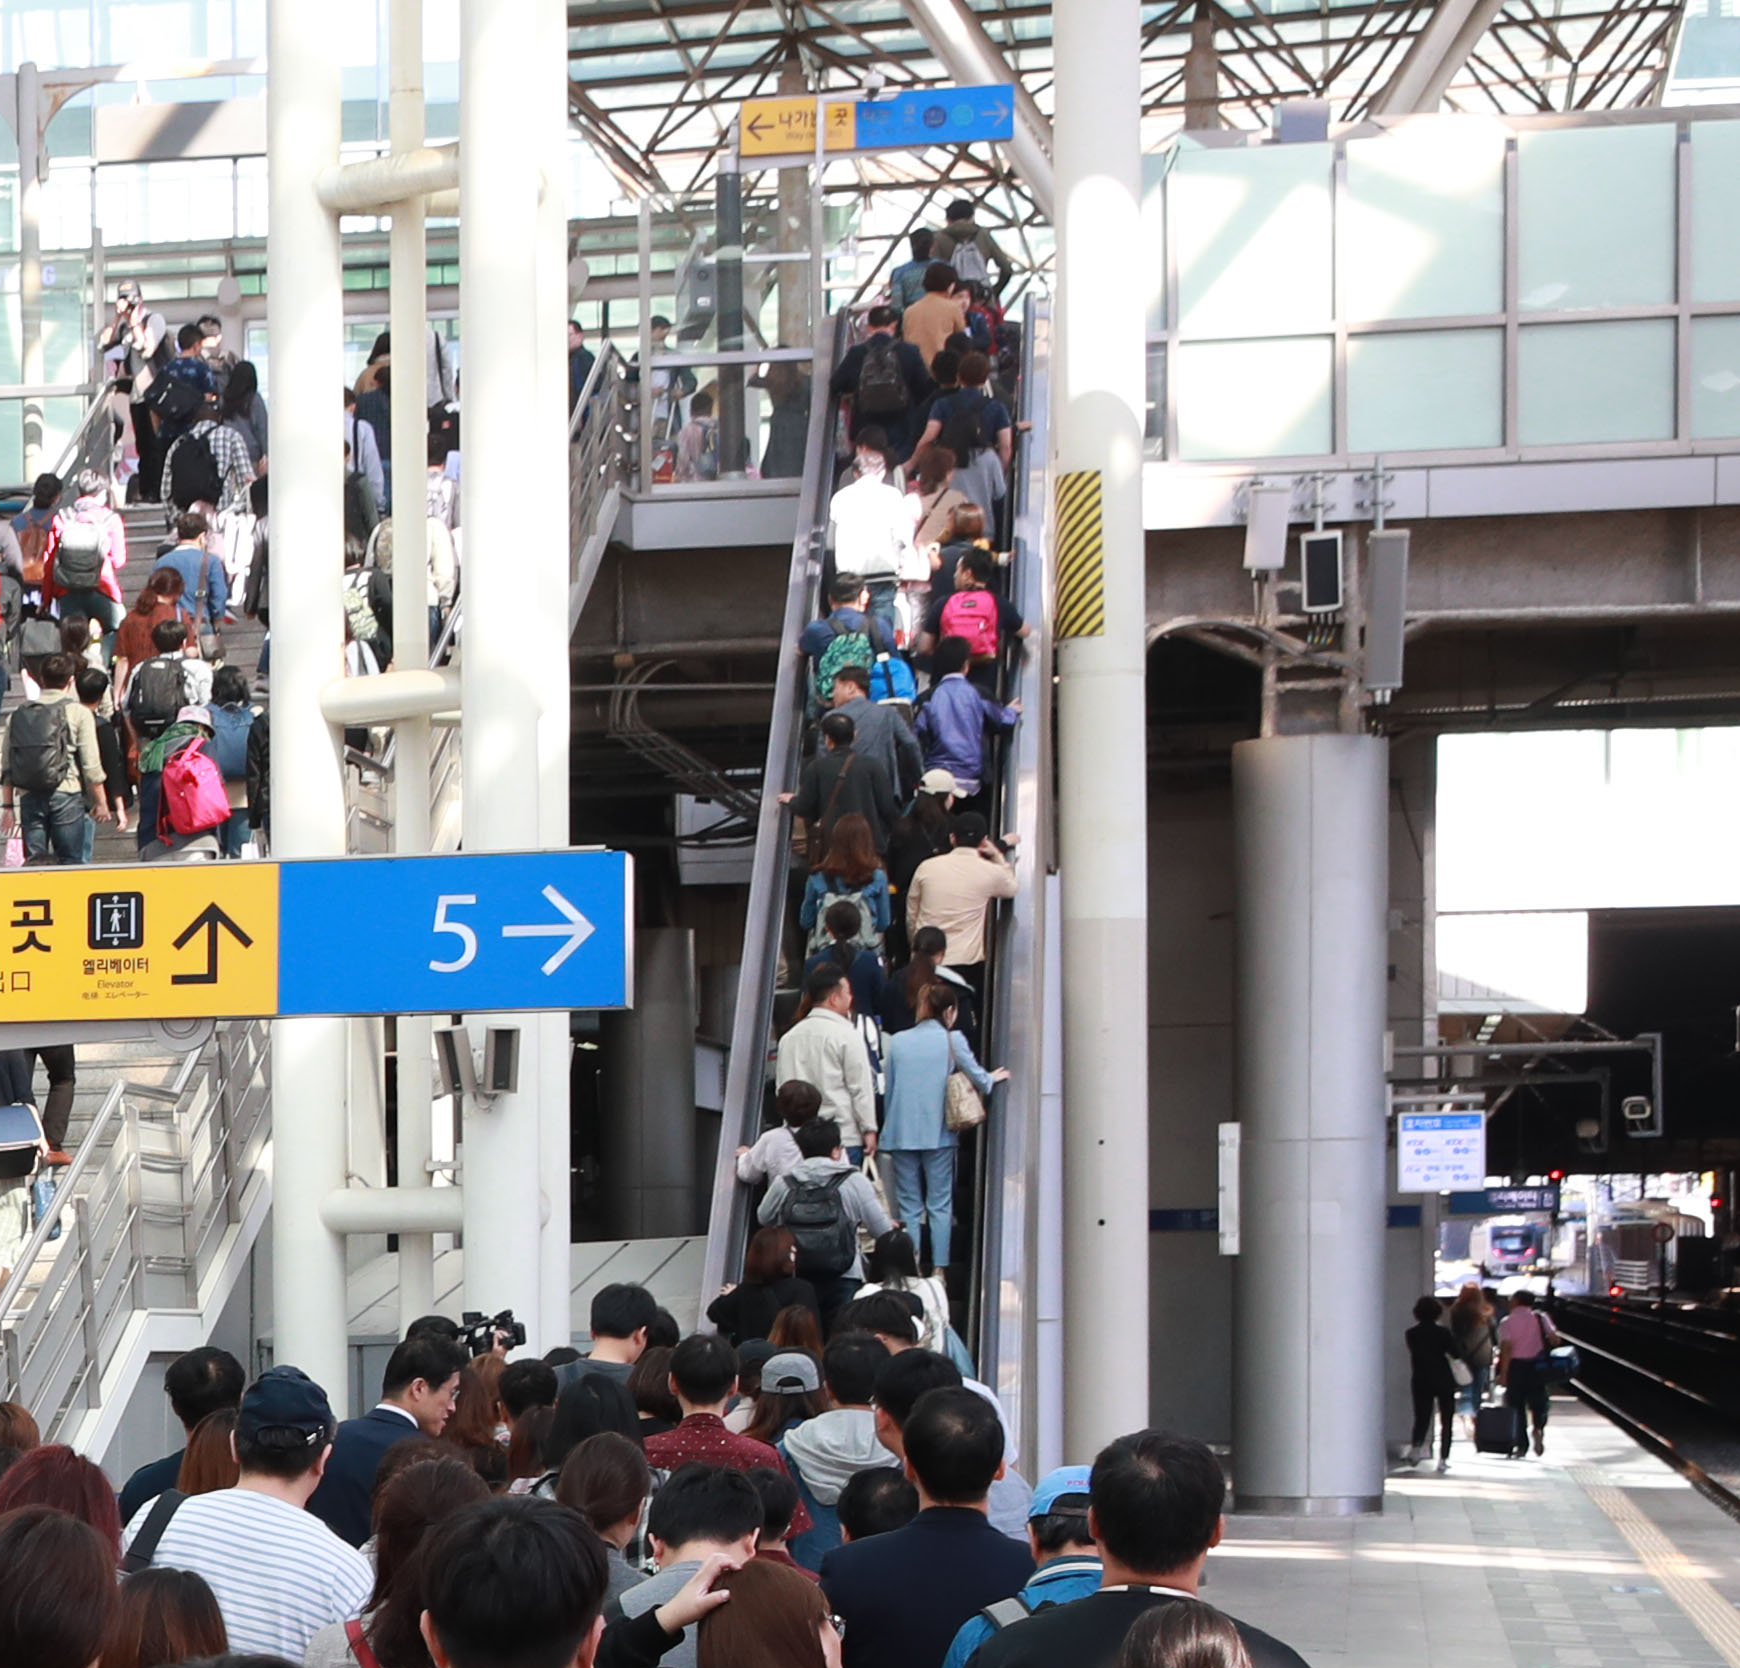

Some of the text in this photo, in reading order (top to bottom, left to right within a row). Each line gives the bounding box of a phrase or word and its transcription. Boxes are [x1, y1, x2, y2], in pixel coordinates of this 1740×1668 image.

[10, 899, 54, 954] 곳
[428, 894, 479, 973] 5
[82, 957, 149, 976] 엘리베이터
[97, 979, 134, 989] Elevator
